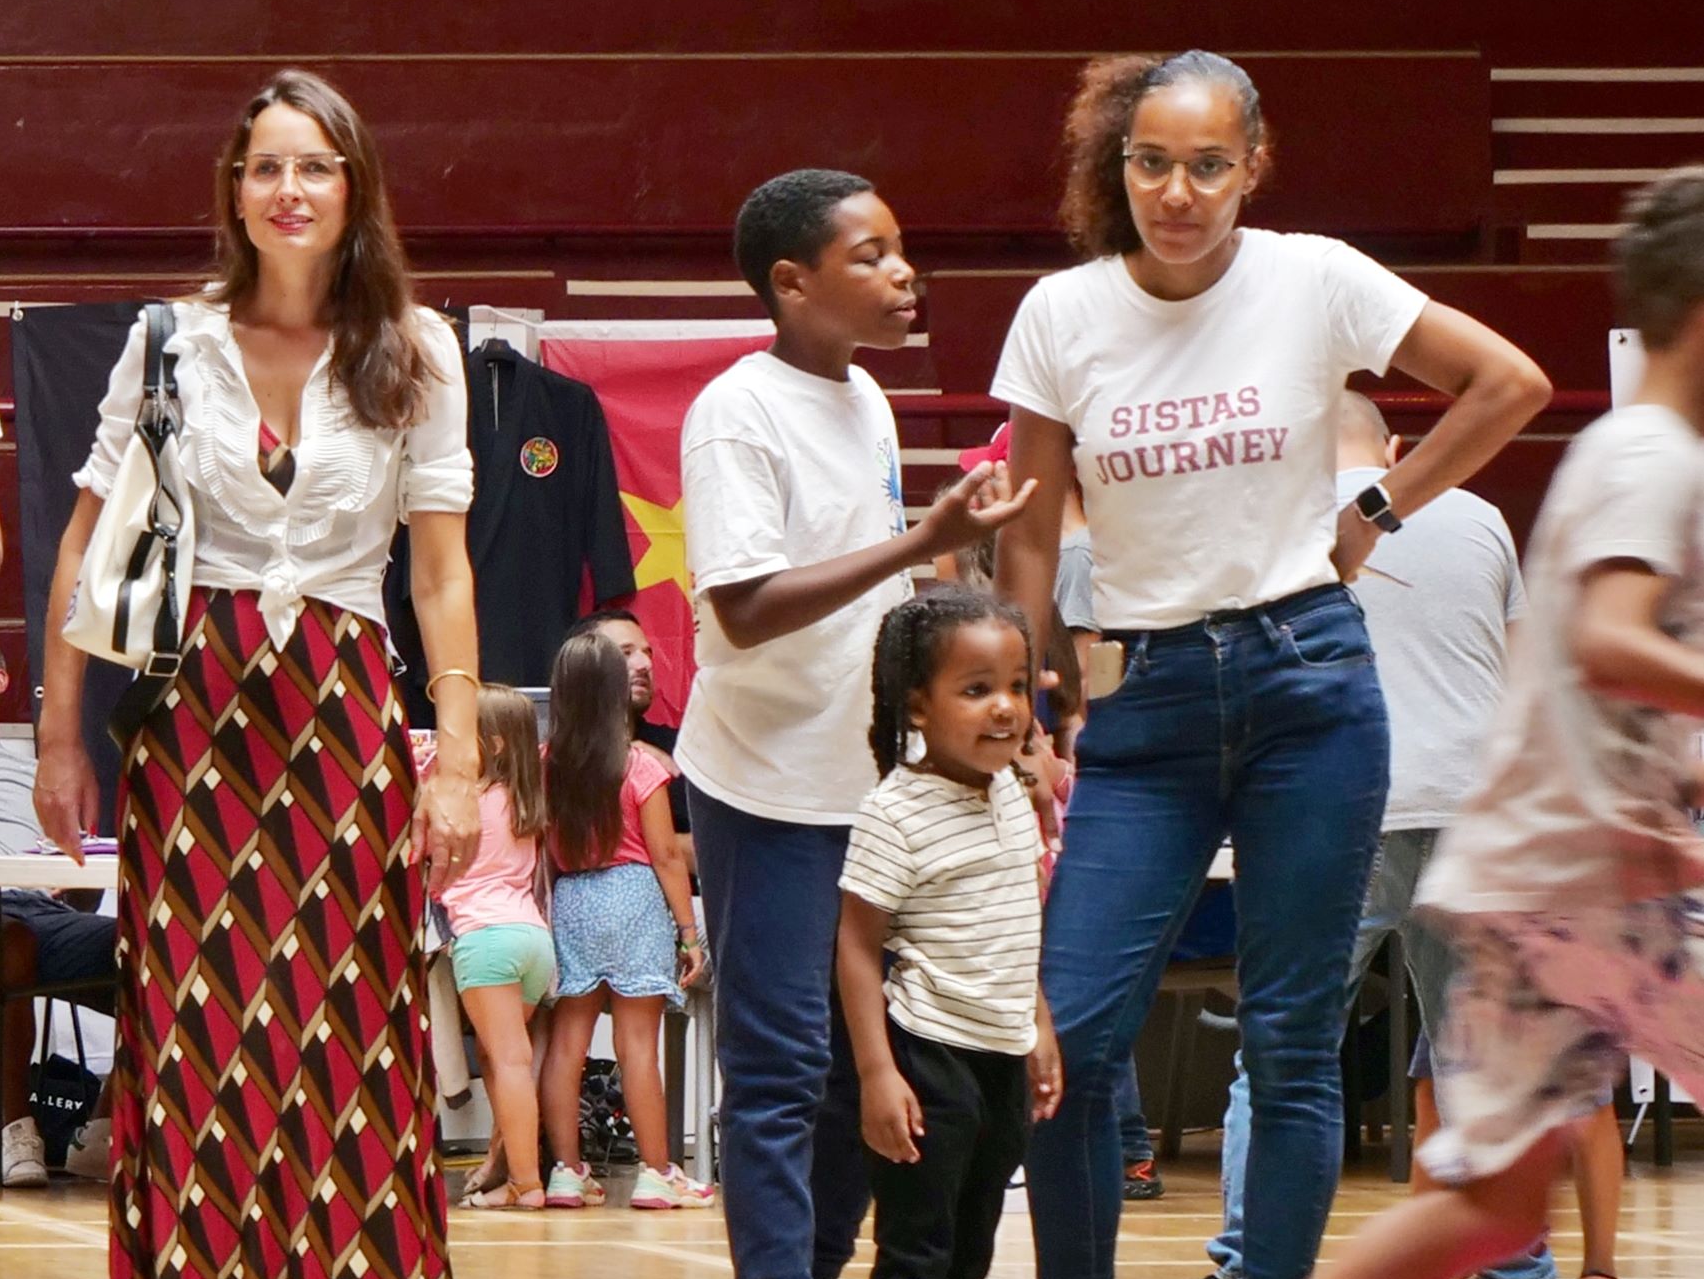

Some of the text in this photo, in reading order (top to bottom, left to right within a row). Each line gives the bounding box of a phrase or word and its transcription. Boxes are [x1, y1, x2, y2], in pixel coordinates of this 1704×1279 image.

[1109, 385, 1261, 439] SISTAS
[1095, 427, 1290, 486] JOURNEY
[28, 1091, 84, 1111] ALERY
